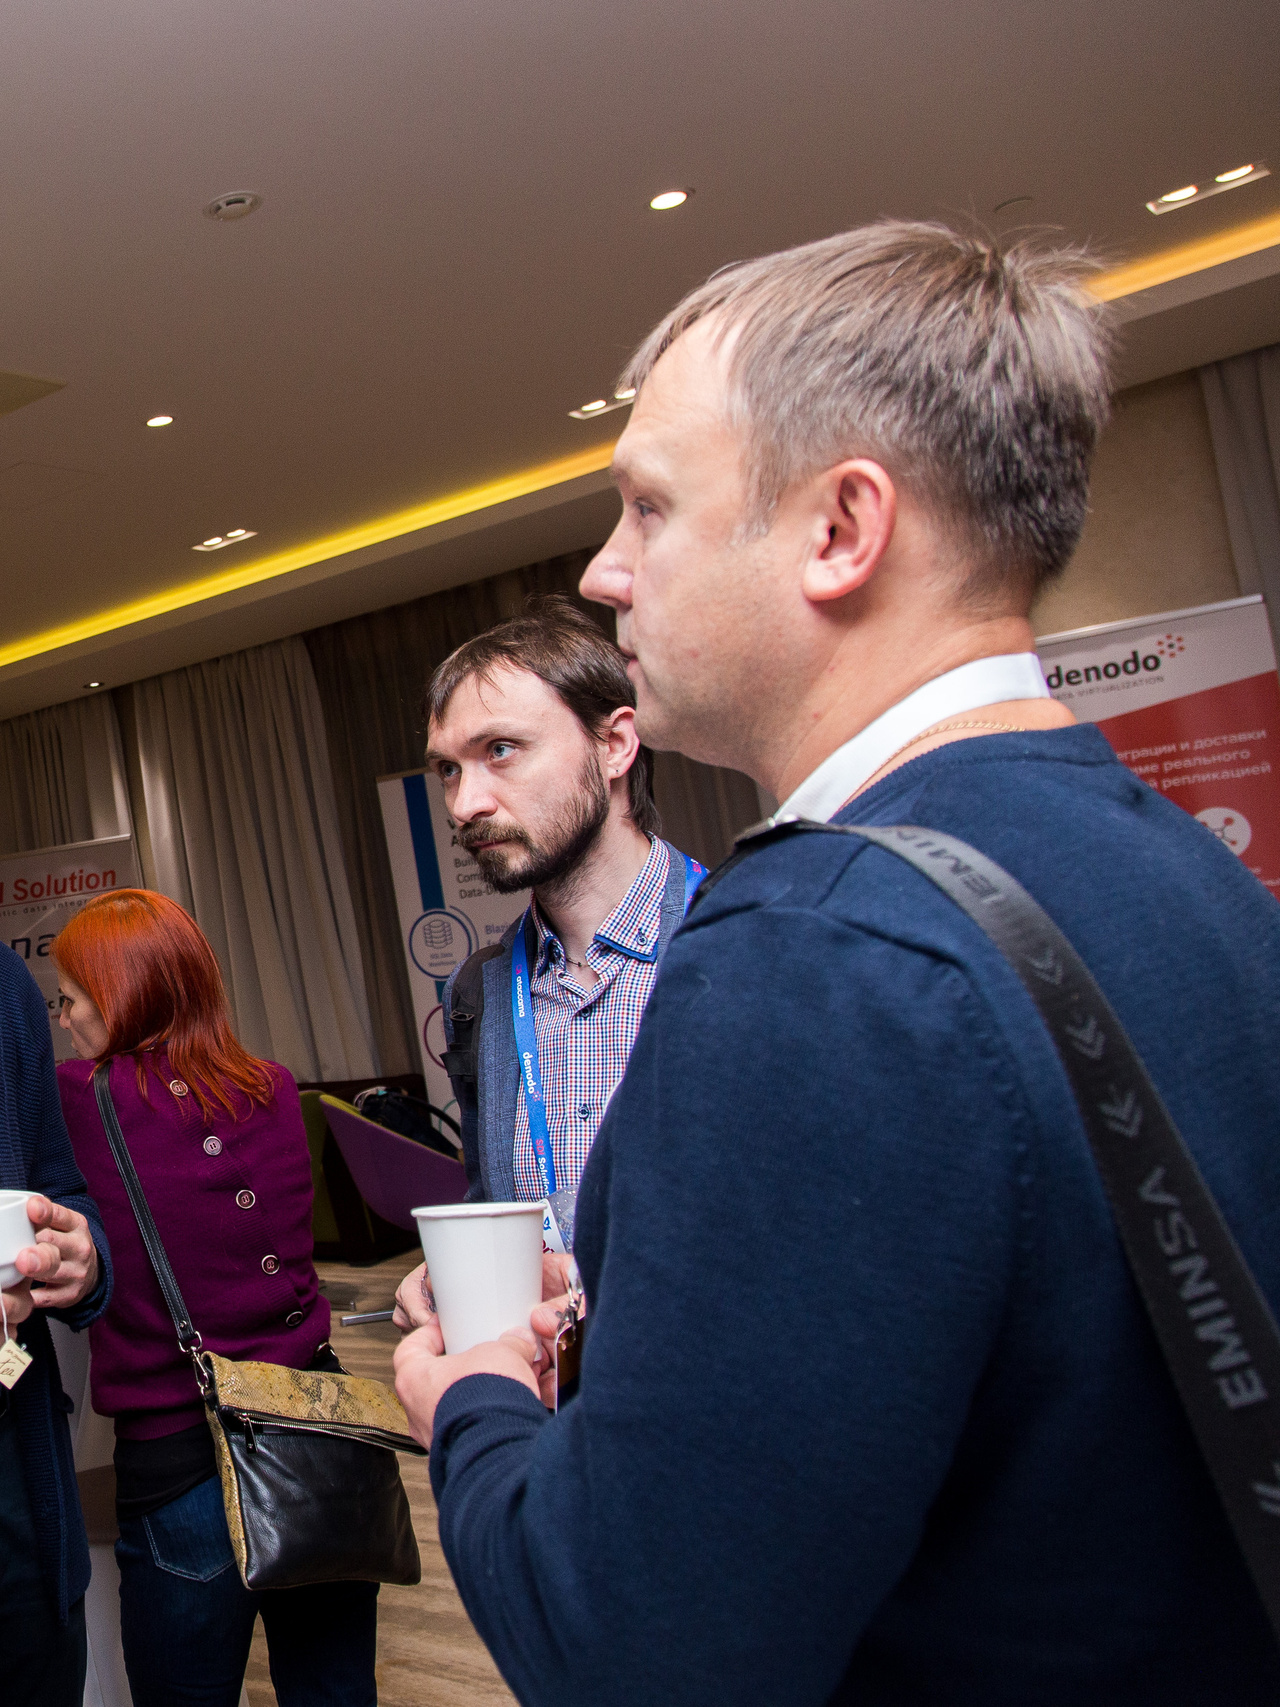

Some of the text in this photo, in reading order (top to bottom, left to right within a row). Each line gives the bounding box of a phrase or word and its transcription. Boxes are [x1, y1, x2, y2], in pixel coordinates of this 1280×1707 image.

[1047, 650, 1161, 689] denodo
[1180, 741, 1190, 751] и
[1193, 729, 1267, 751] доставки
[1162, 761, 1271, 791] репликацией
[1163, 750, 1251, 773] реального
[13, 869, 117, 901] Solution
[23, 905, 48, 914] data
[53, 898, 89, 909] integr
[516, 975, 526, 1018] ataccama
[522, 1051, 537, 1095] denodo
[535, 1138, 545, 1156] SDI
[1138, 1164, 1270, 1410] EMINSA
